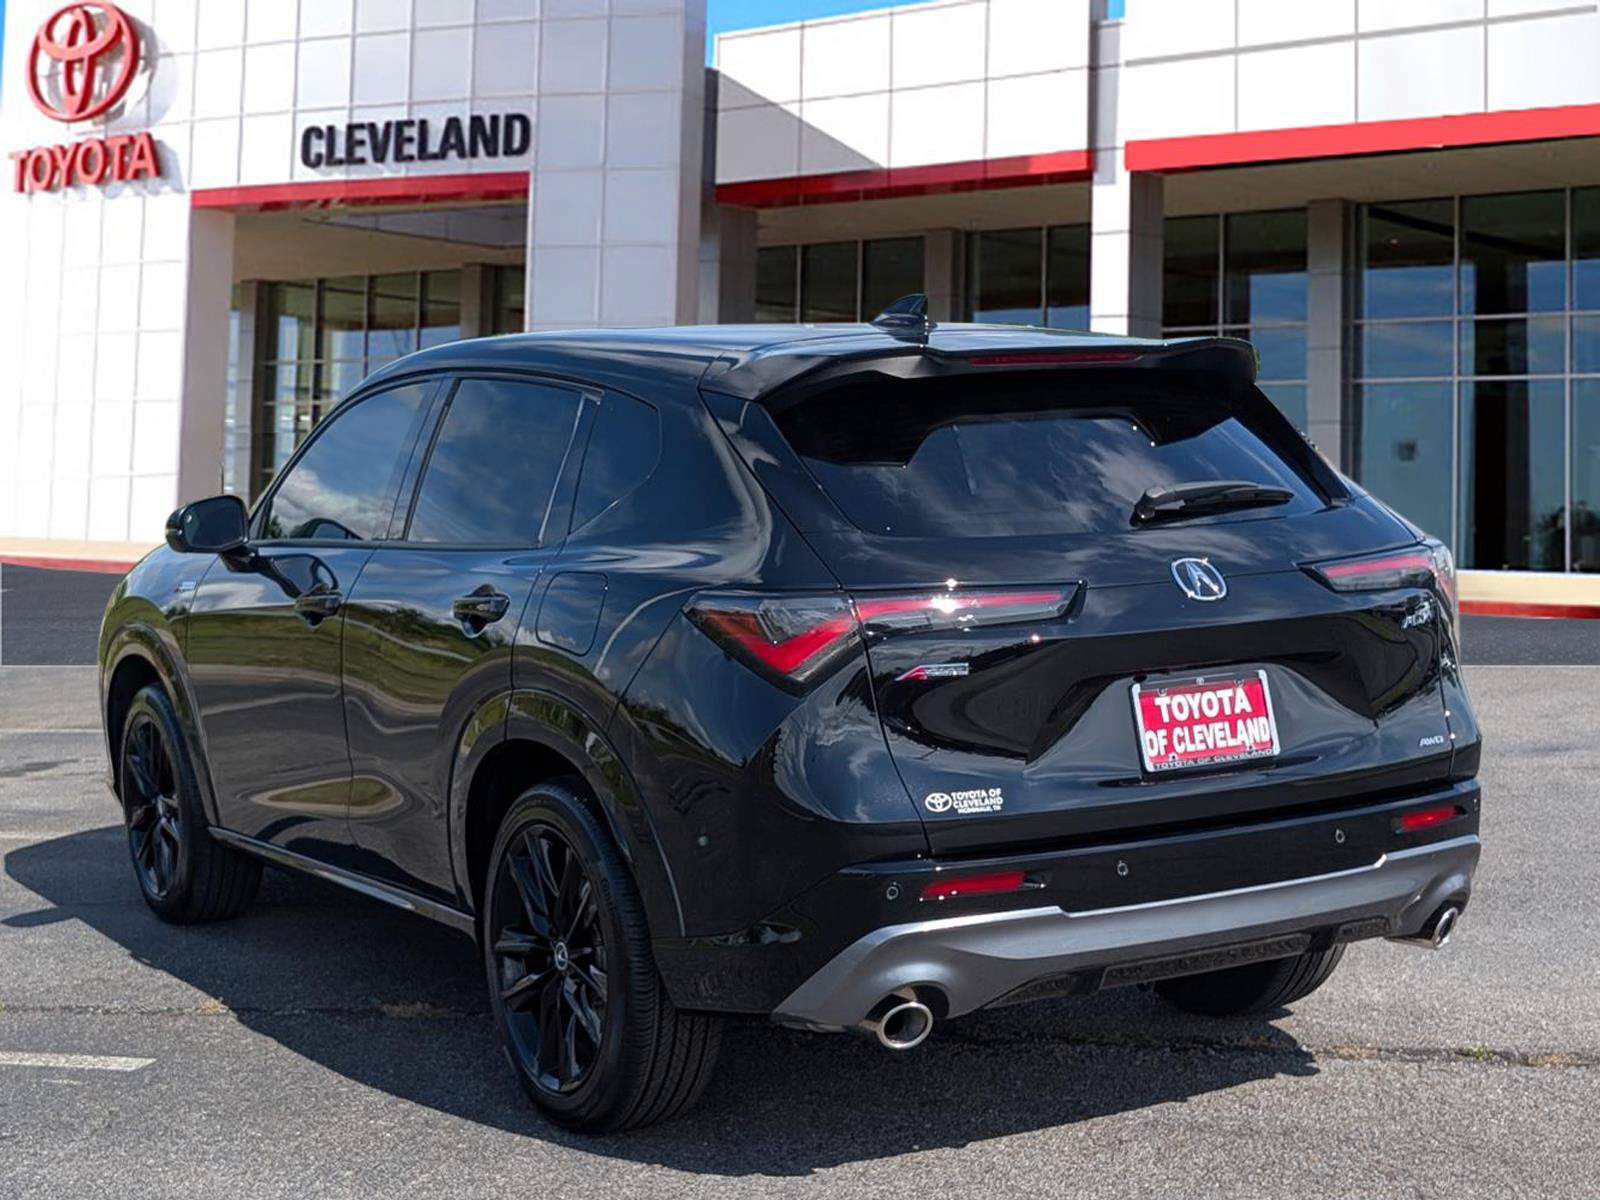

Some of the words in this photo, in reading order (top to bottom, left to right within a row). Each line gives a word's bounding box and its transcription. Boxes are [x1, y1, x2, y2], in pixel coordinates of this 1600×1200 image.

[301, 113, 531, 169] CLEVELAND
[8, 132, 161, 193] TOYOTA
[1155, 687, 1252, 723] TOYOTA
[1145, 729, 1167, 757] OF
[1172, 716, 1271, 754] CLEVELAND
[1419, 735, 1443, 747] AWD
[1155, 758, 1195, 769] TOYOTA
[1197, 757, 1211, 766] OF
[1213, 749, 1274, 763] CLEVELAND
[951, 789, 988, 801] TOYOTA
[988, 788, 1001, 798] OF
[953, 797, 1003, 809] CLEVELAND
